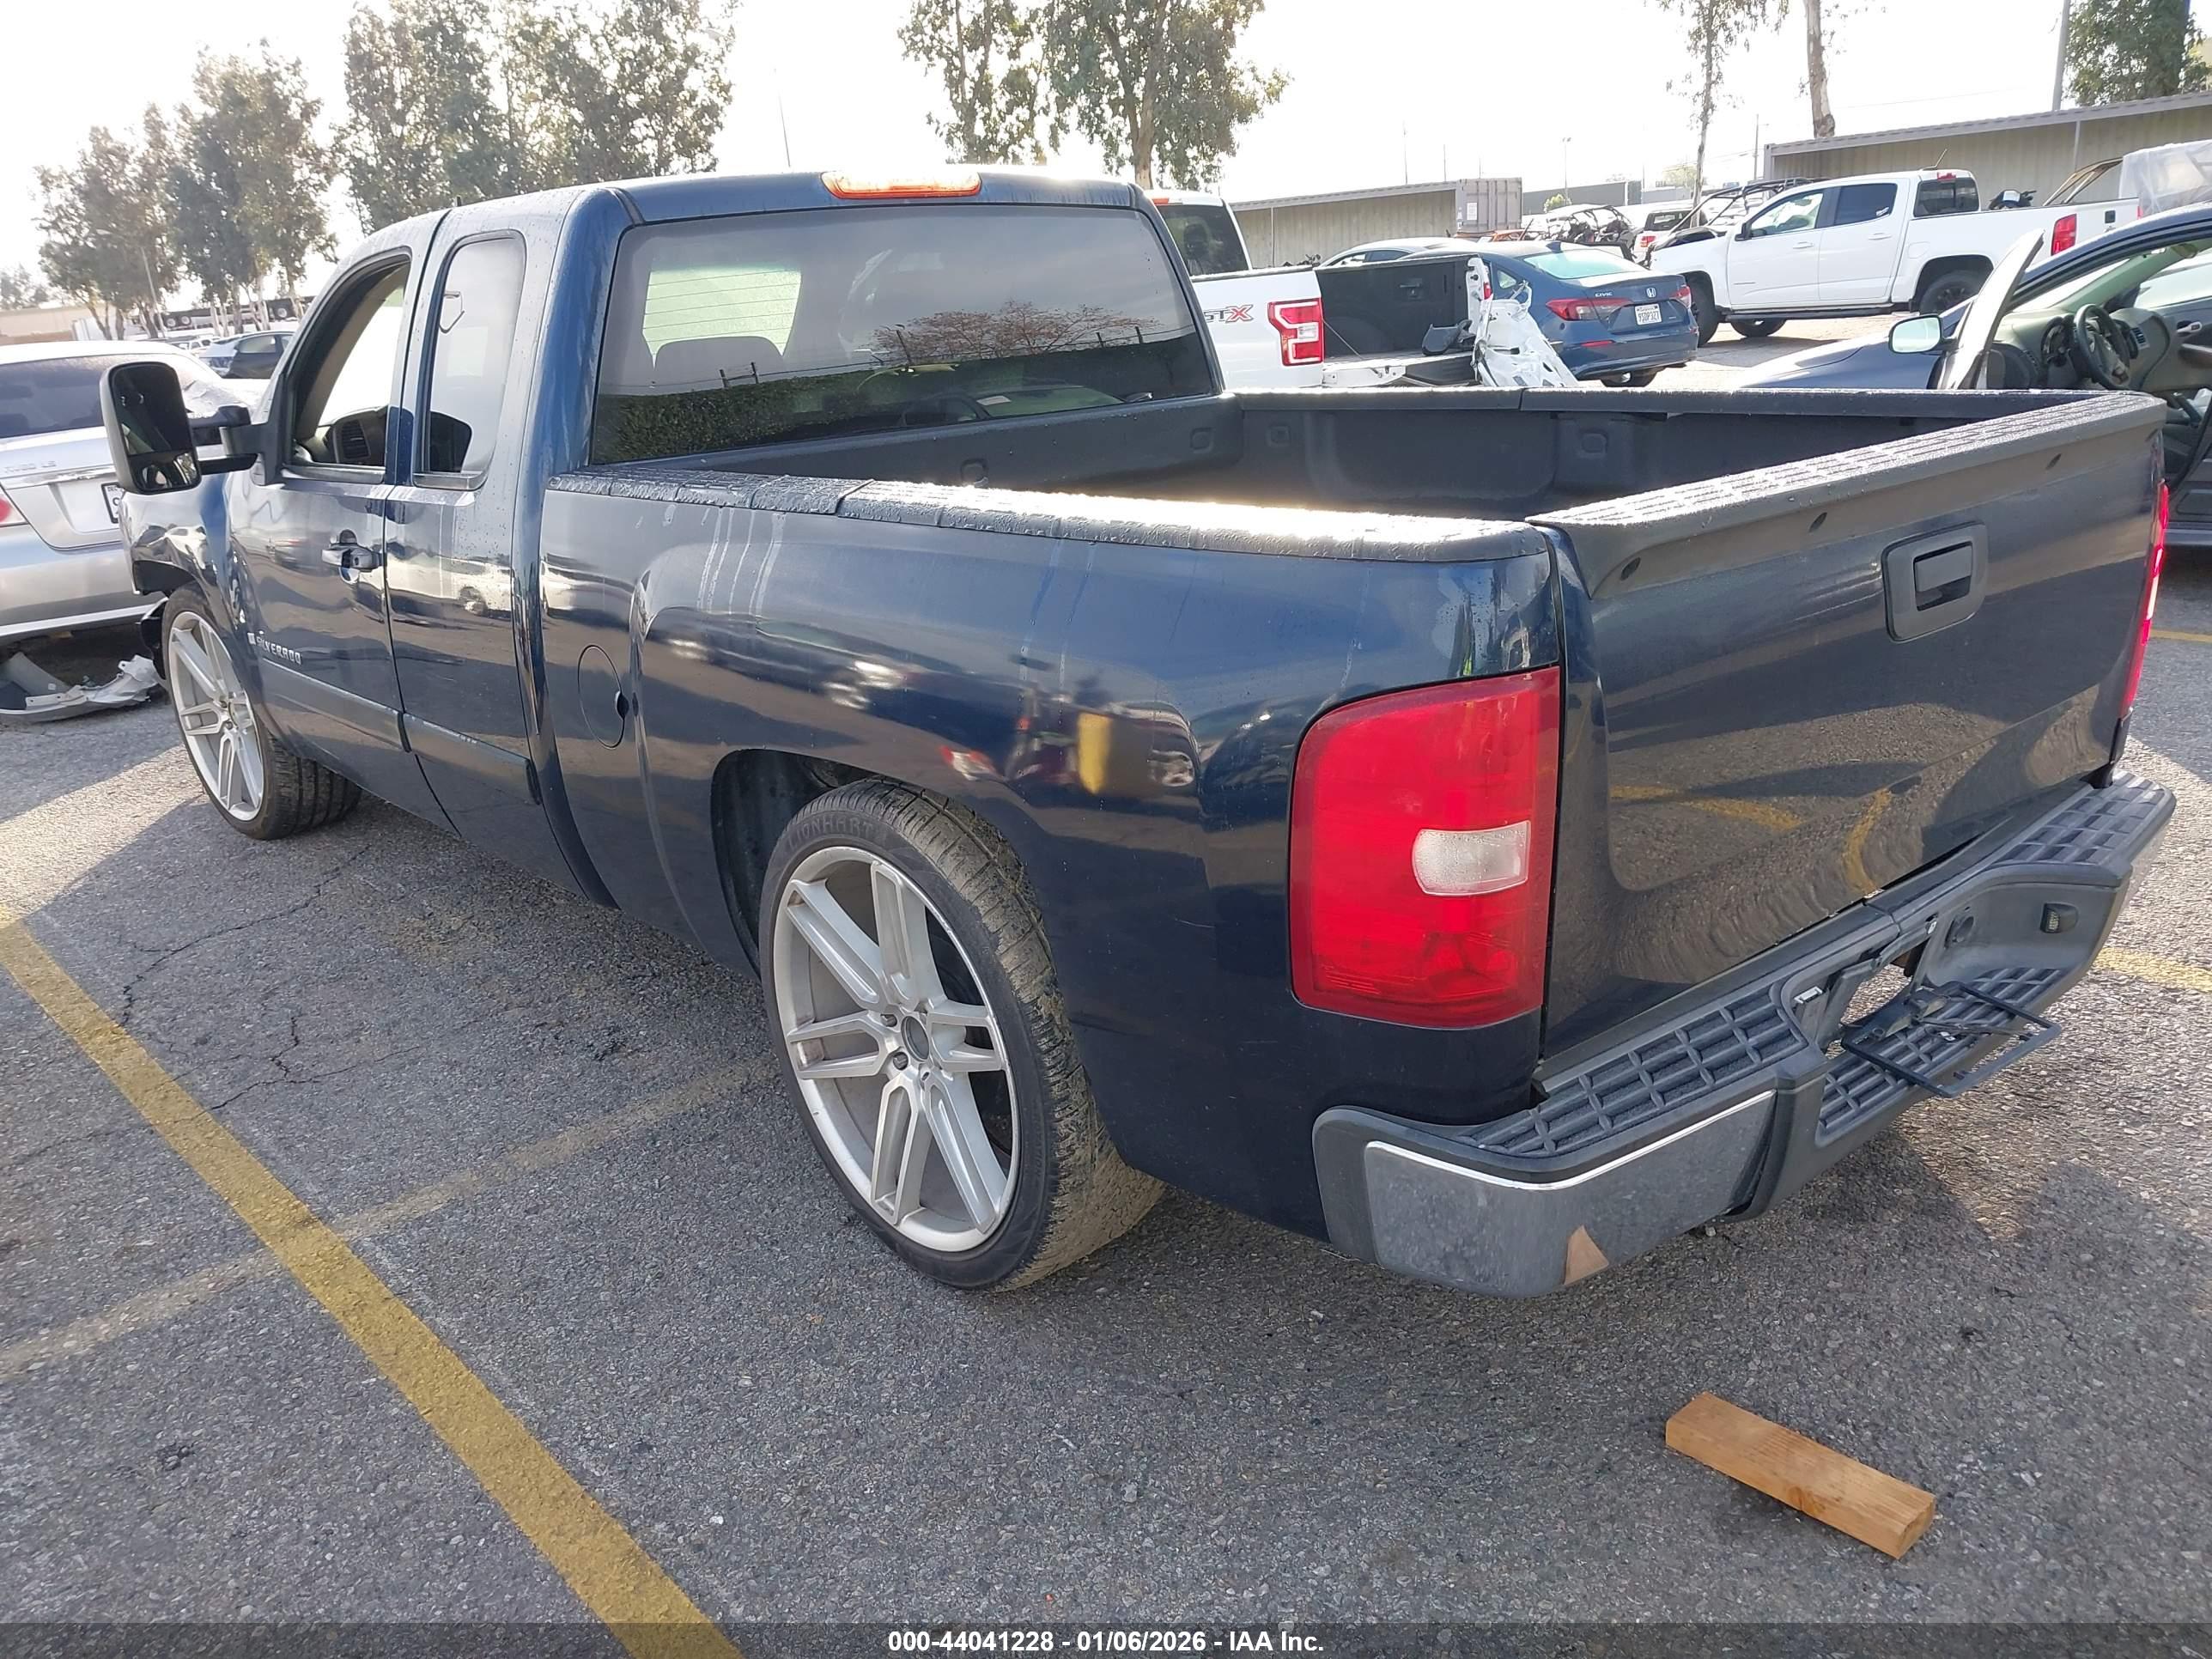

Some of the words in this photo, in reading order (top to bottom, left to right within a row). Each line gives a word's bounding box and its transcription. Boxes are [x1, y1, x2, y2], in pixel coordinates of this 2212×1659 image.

[1203, 304, 1254, 323] STX
[256, 636, 302, 665] SILVERADO
[787, 815, 874, 850] LIONHART
